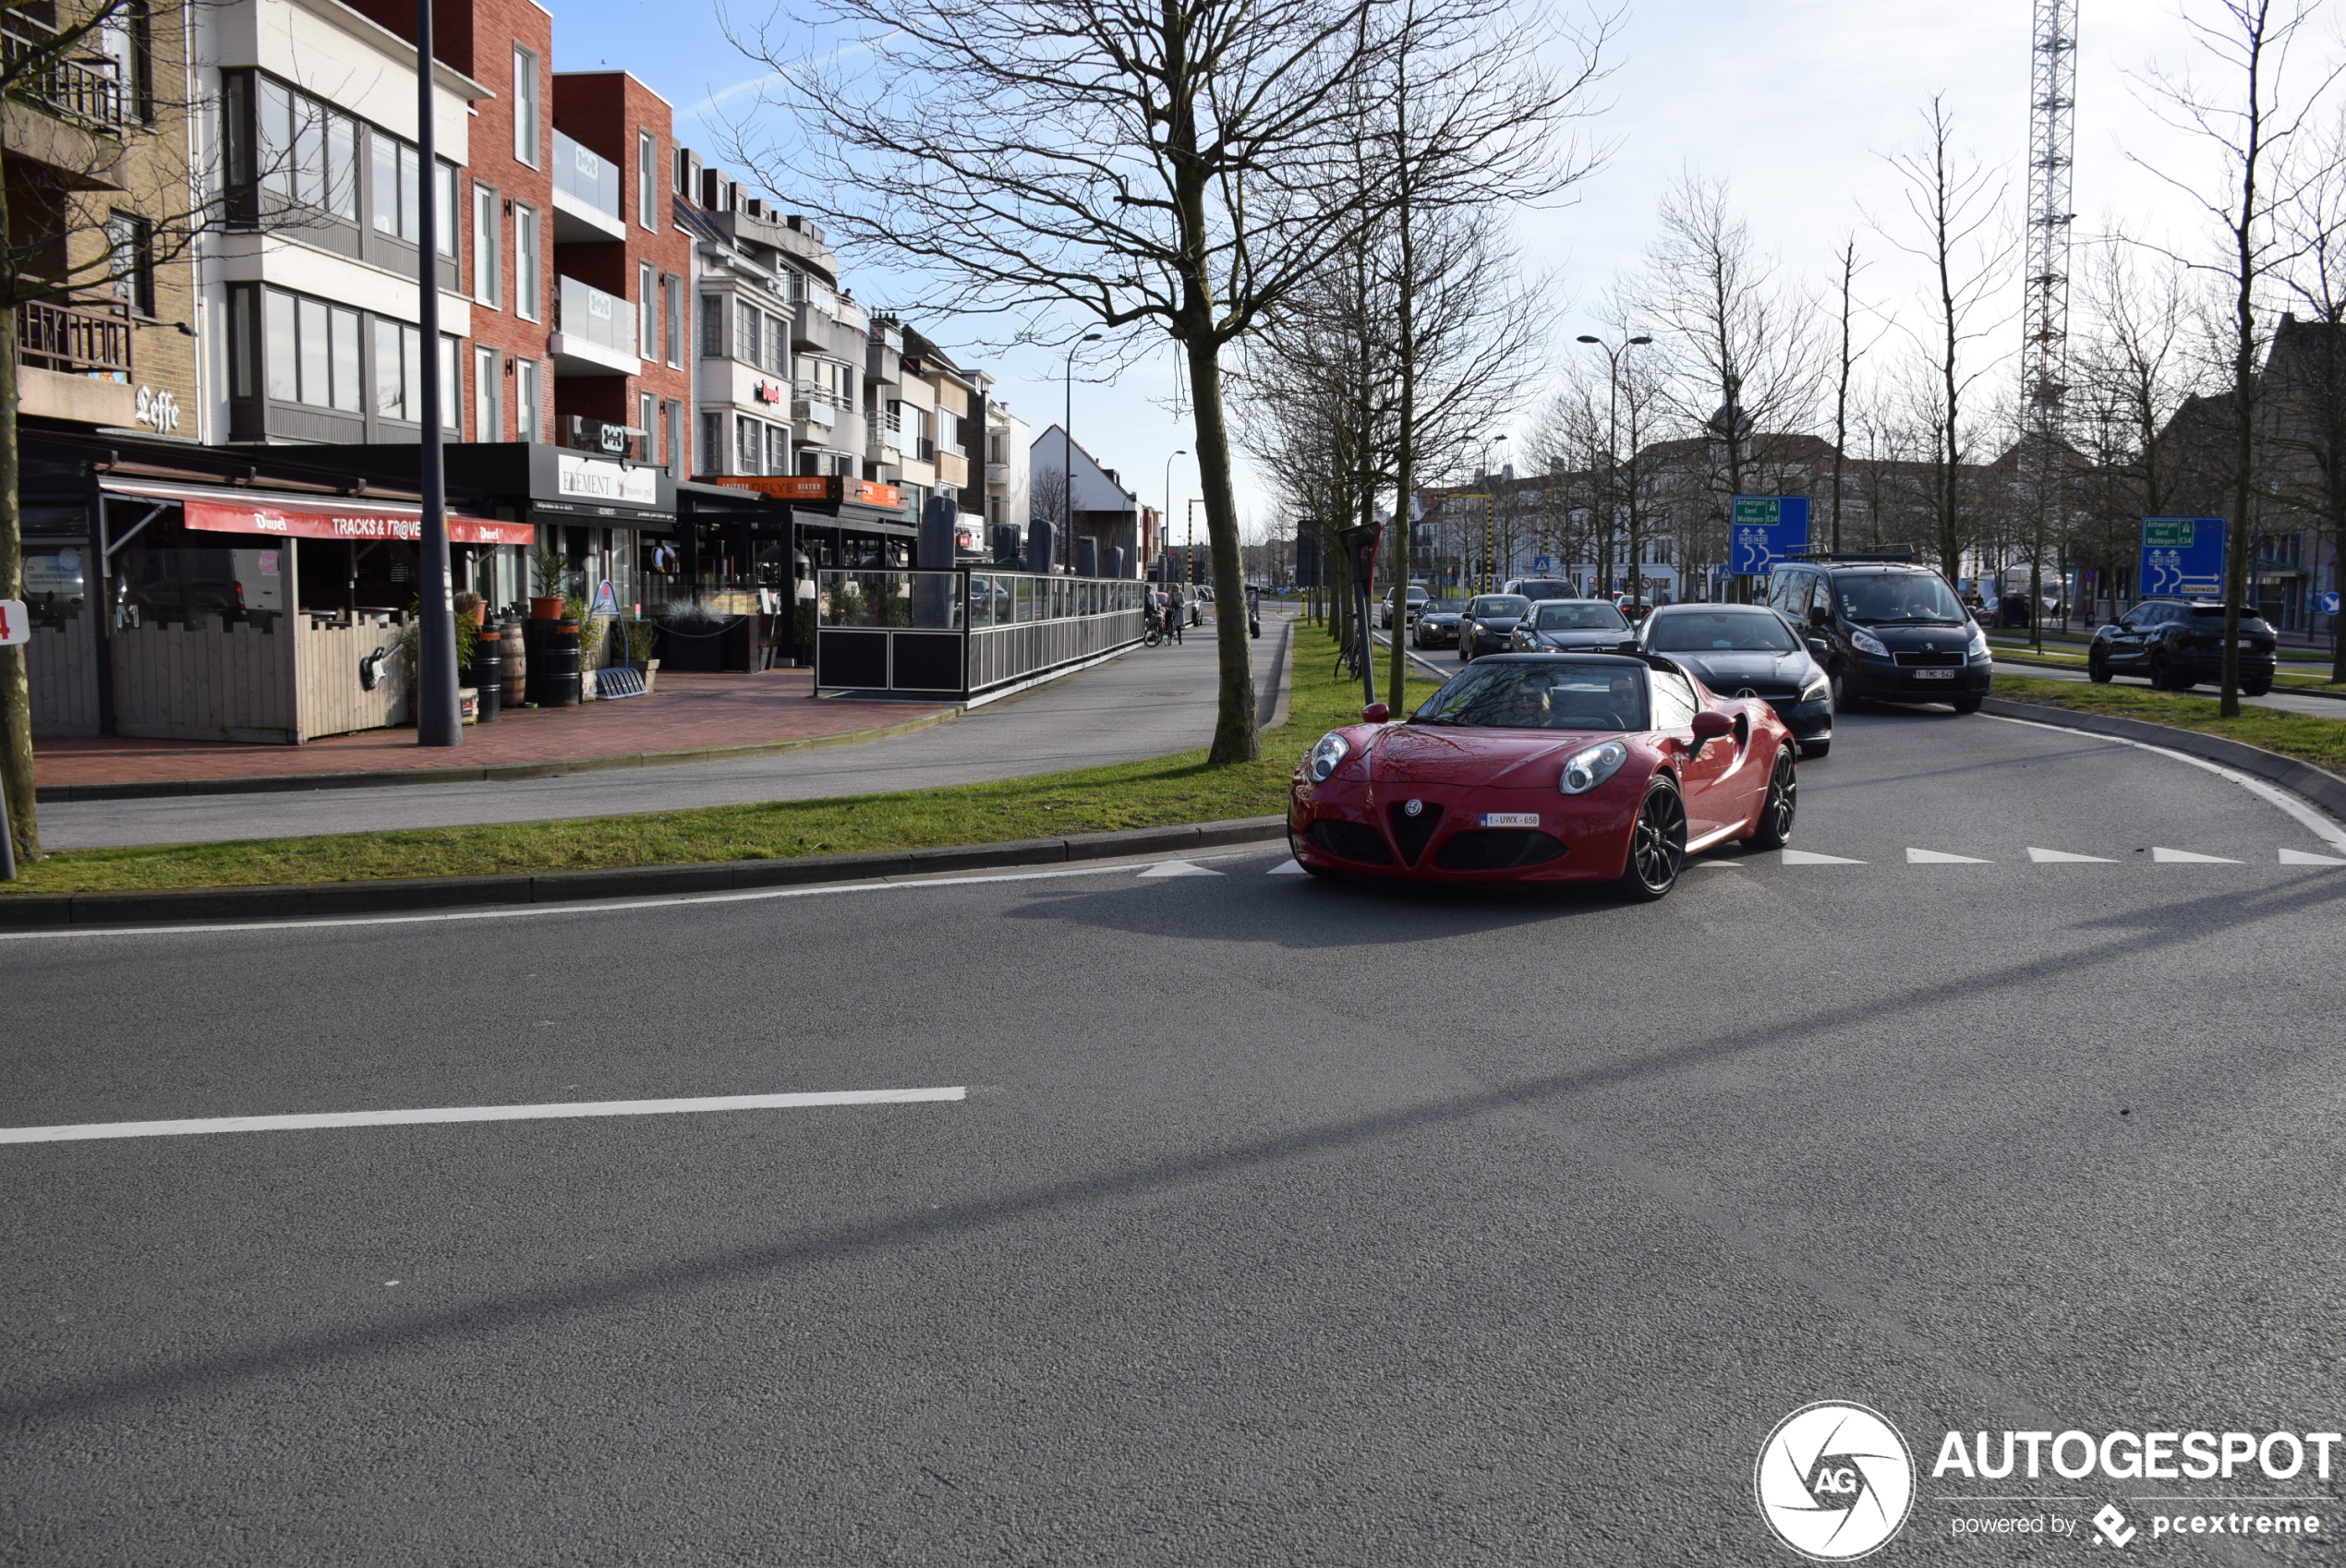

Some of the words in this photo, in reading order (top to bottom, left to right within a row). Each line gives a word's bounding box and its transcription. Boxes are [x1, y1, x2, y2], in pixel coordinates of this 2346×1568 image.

[136, 383, 181, 433] Leffe
[563, 471, 611, 495] ELEMENT
[752, 482, 793, 494] DELYE
[797, 482, 821, 491] BISTRO
[1737, 499, 1765, 507] Antwerpen
[1737, 515, 1764, 524] Maldegem
[2147, 521, 2178, 529] Antwerpen
[254, 512, 287, 532] Duvel
[333, 518, 377, 536] TRACKS
[377, 519, 385, 537] &
[479, 525, 500, 540] Duvel
